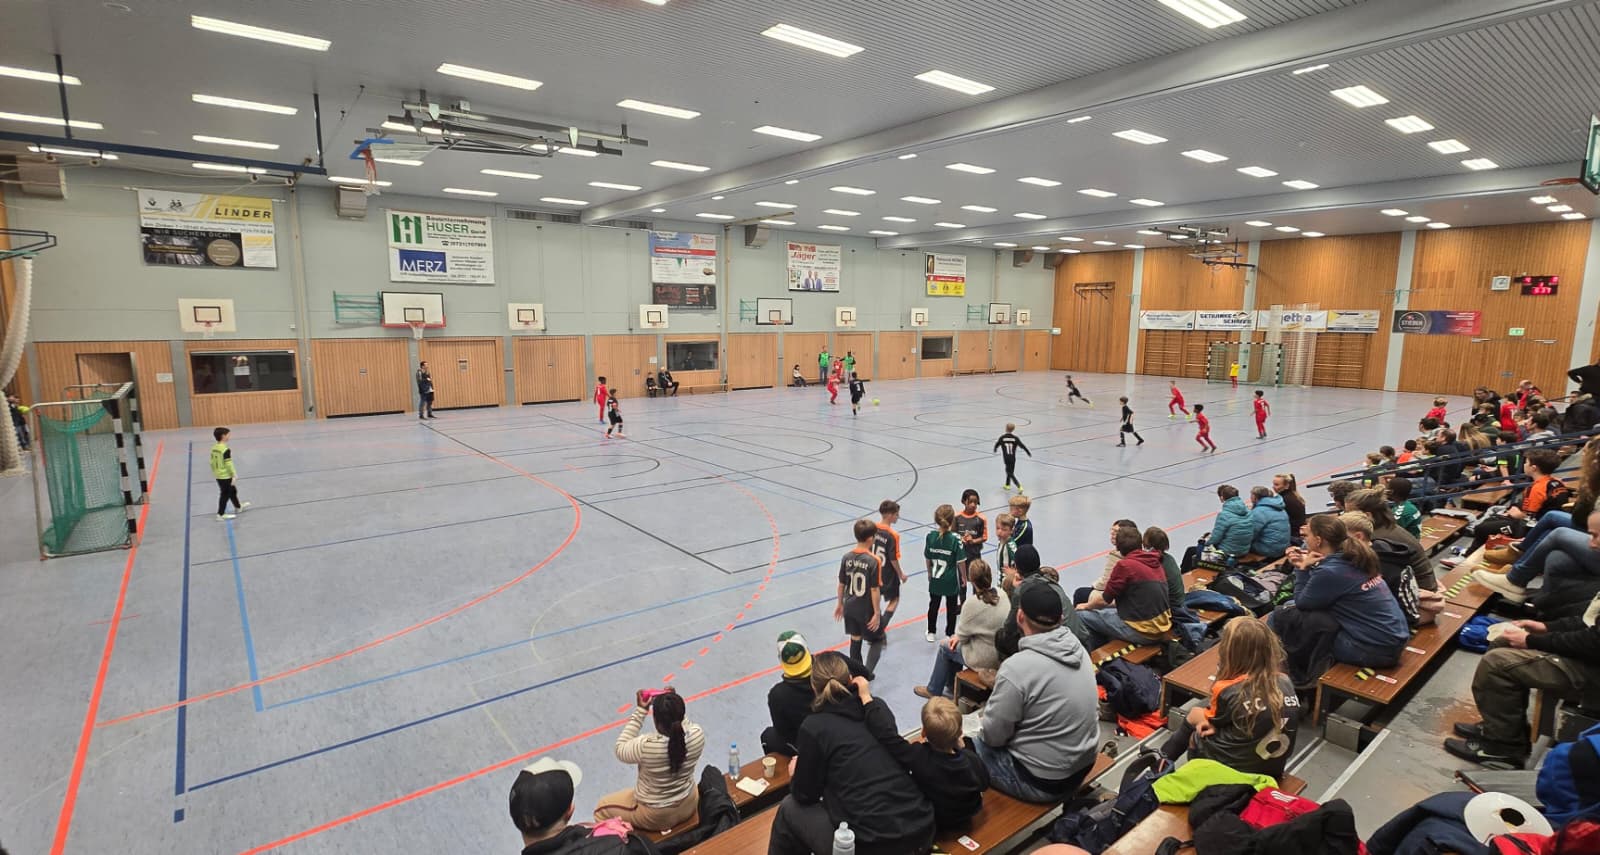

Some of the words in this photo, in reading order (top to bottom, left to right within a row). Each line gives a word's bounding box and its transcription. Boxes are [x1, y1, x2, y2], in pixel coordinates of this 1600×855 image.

[215, 207, 272, 219] LINDER
[426, 222, 470, 234] HUSER
[402, 258, 443, 273] MERZ
[931, 558, 948, 579] 17
[846, 571, 867, 598] 10
